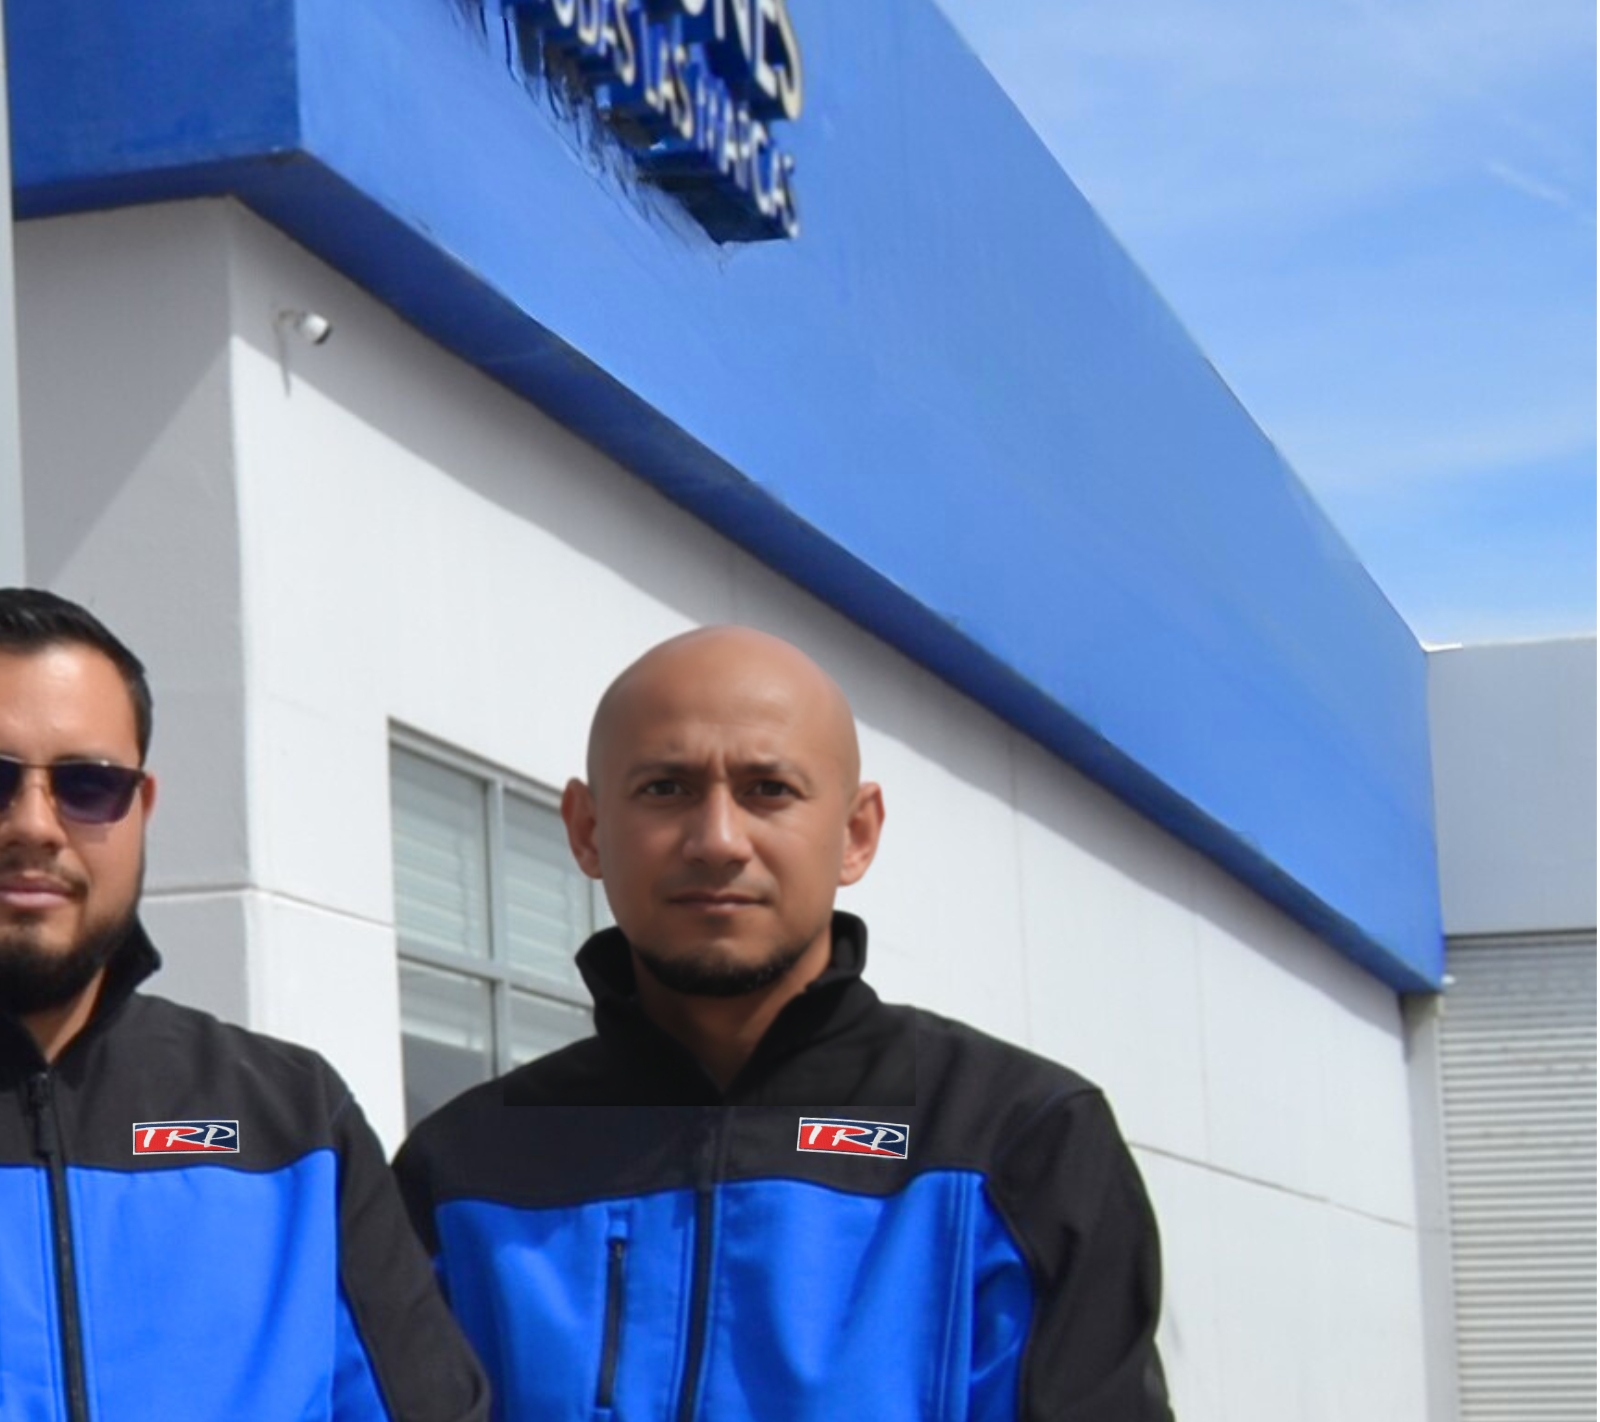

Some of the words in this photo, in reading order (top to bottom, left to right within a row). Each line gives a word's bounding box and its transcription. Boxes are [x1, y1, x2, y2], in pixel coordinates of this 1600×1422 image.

[638, 10, 694, 140] LAS
[134, 1123, 238, 1151] TRP
[800, 1122, 906, 1157] TRP
